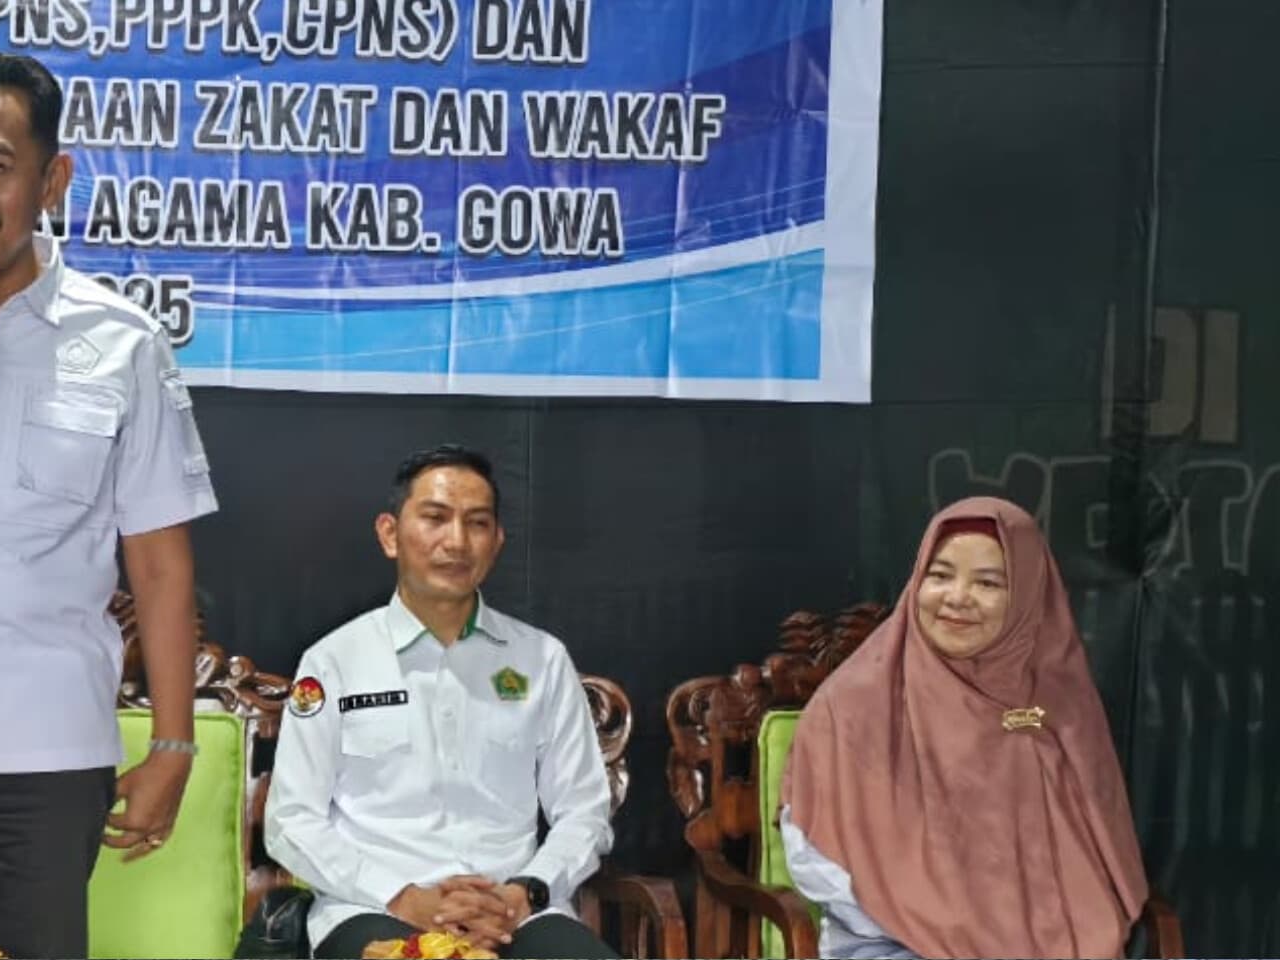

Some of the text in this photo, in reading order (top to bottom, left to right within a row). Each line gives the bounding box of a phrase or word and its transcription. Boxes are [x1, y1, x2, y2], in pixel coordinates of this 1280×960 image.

[472, 0, 589, 64] DAN
[194, 81, 376, 157] ZAKAT
[390, 86, 506, 158] DAN
[522, 91, 725, 163] WAKAF
[84, 175, 289, 250] AGAMA
[307, 181, 440, 255] KAB.
[459, 187, 626, 258] GOWA
